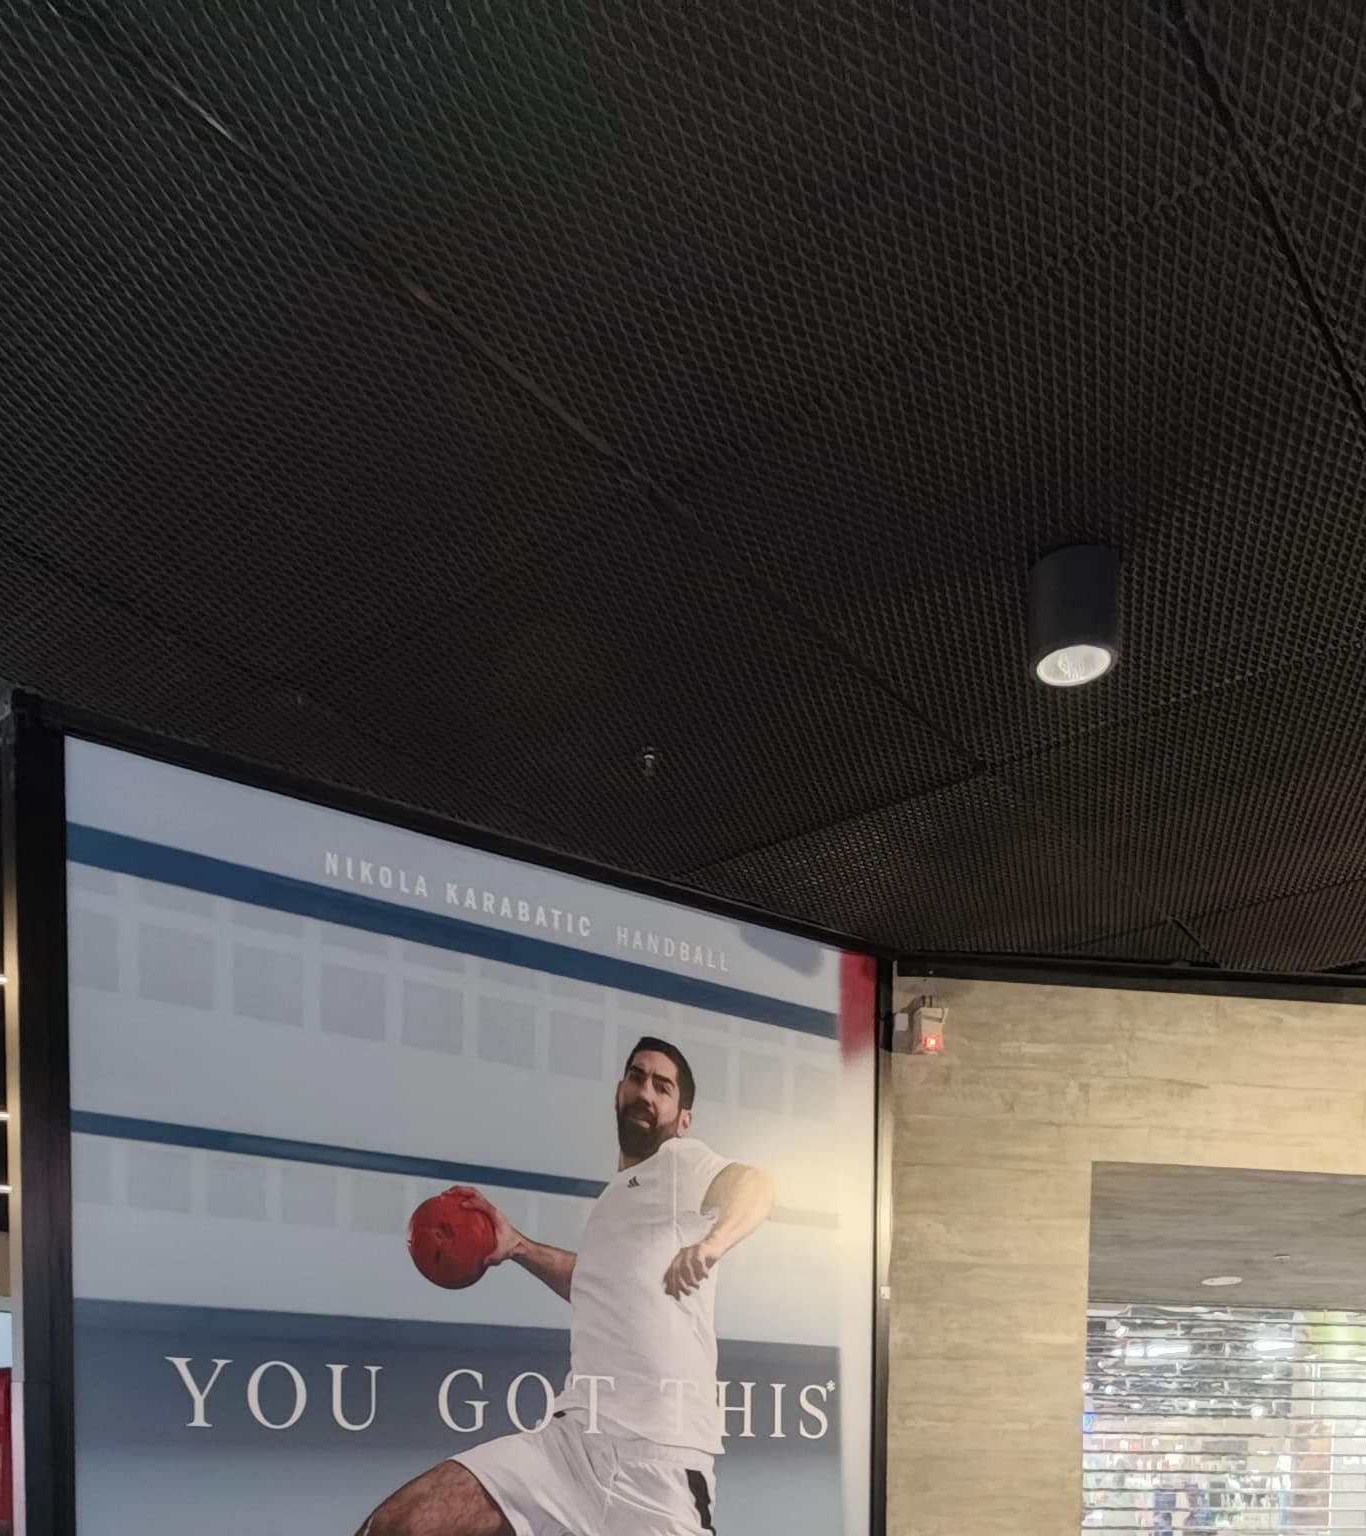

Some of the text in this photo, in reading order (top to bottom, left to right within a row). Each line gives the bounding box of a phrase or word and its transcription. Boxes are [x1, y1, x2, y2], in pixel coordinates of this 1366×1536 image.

[324, 851, 730, 972] NIKOLA KARABATIC HANDBALL
[164, 1356, 383, 1431] YOU
[438, 1368, 616, 1434] GOT
